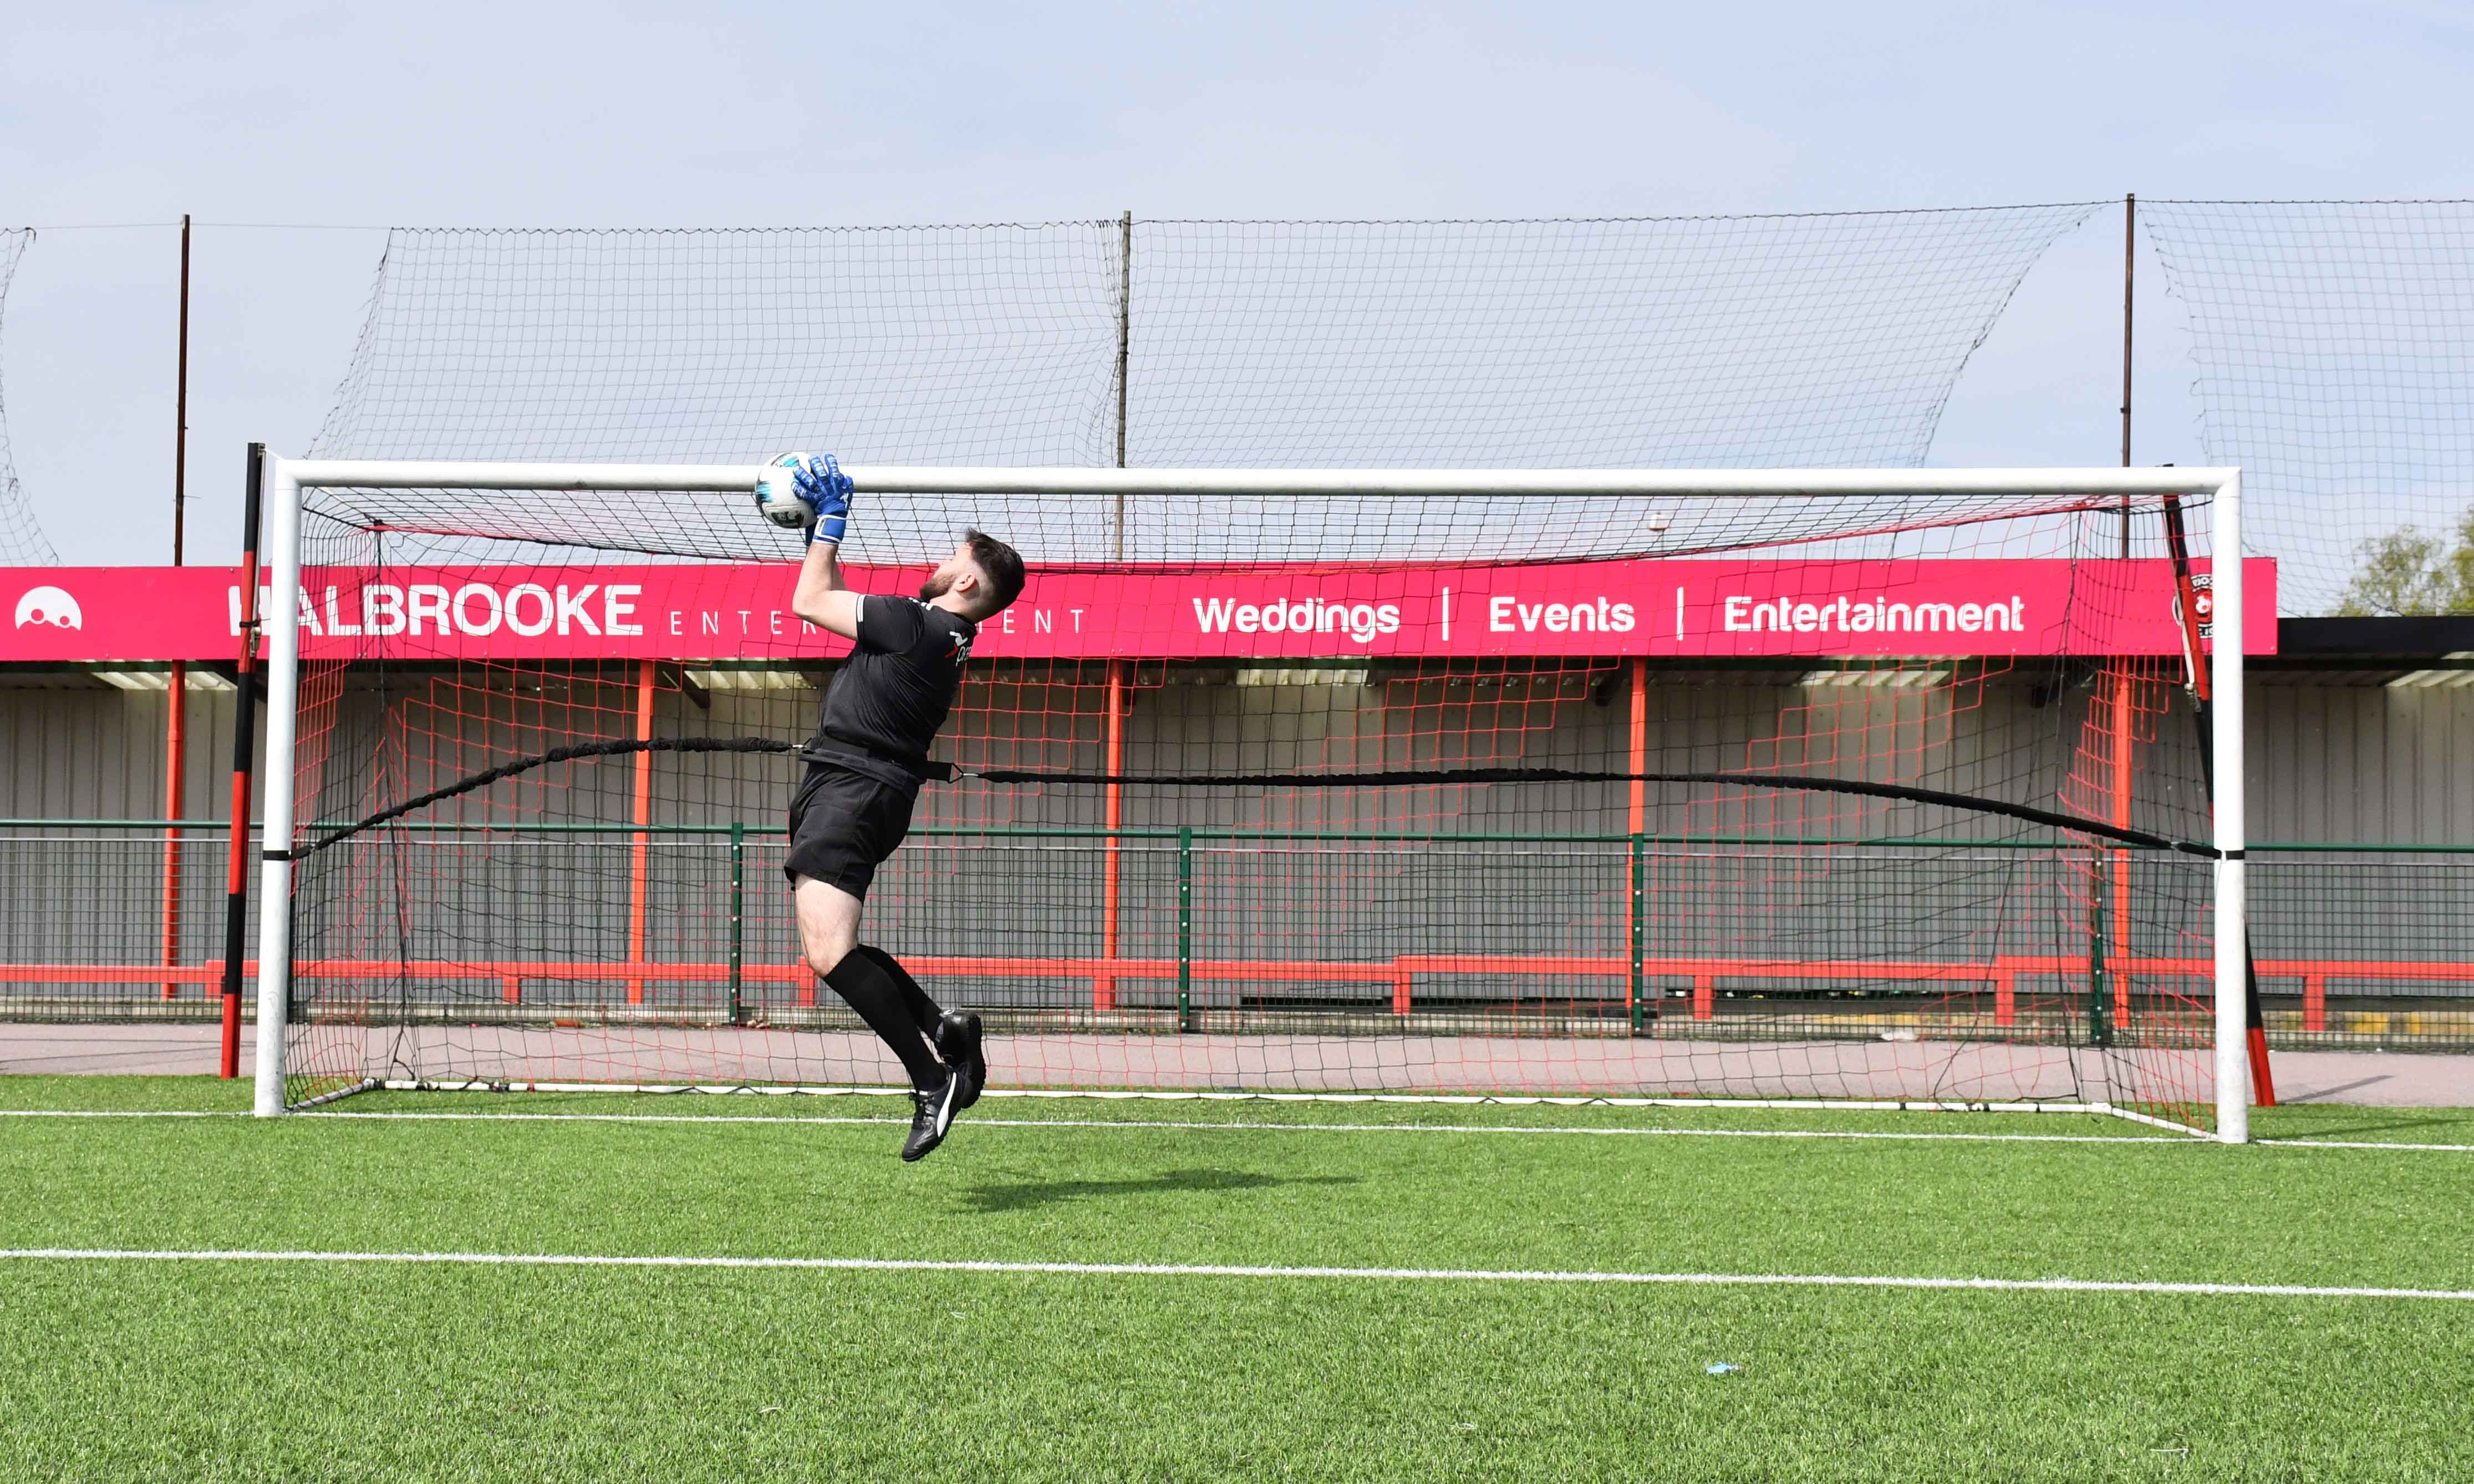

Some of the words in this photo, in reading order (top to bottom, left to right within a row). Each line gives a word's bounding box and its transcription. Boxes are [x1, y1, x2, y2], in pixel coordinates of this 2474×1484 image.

[1193, 597, 1400, 643] Weddings
[1489, 596, 1635, 632] Events
[1724, 595, 2025, 632] Entertainment
